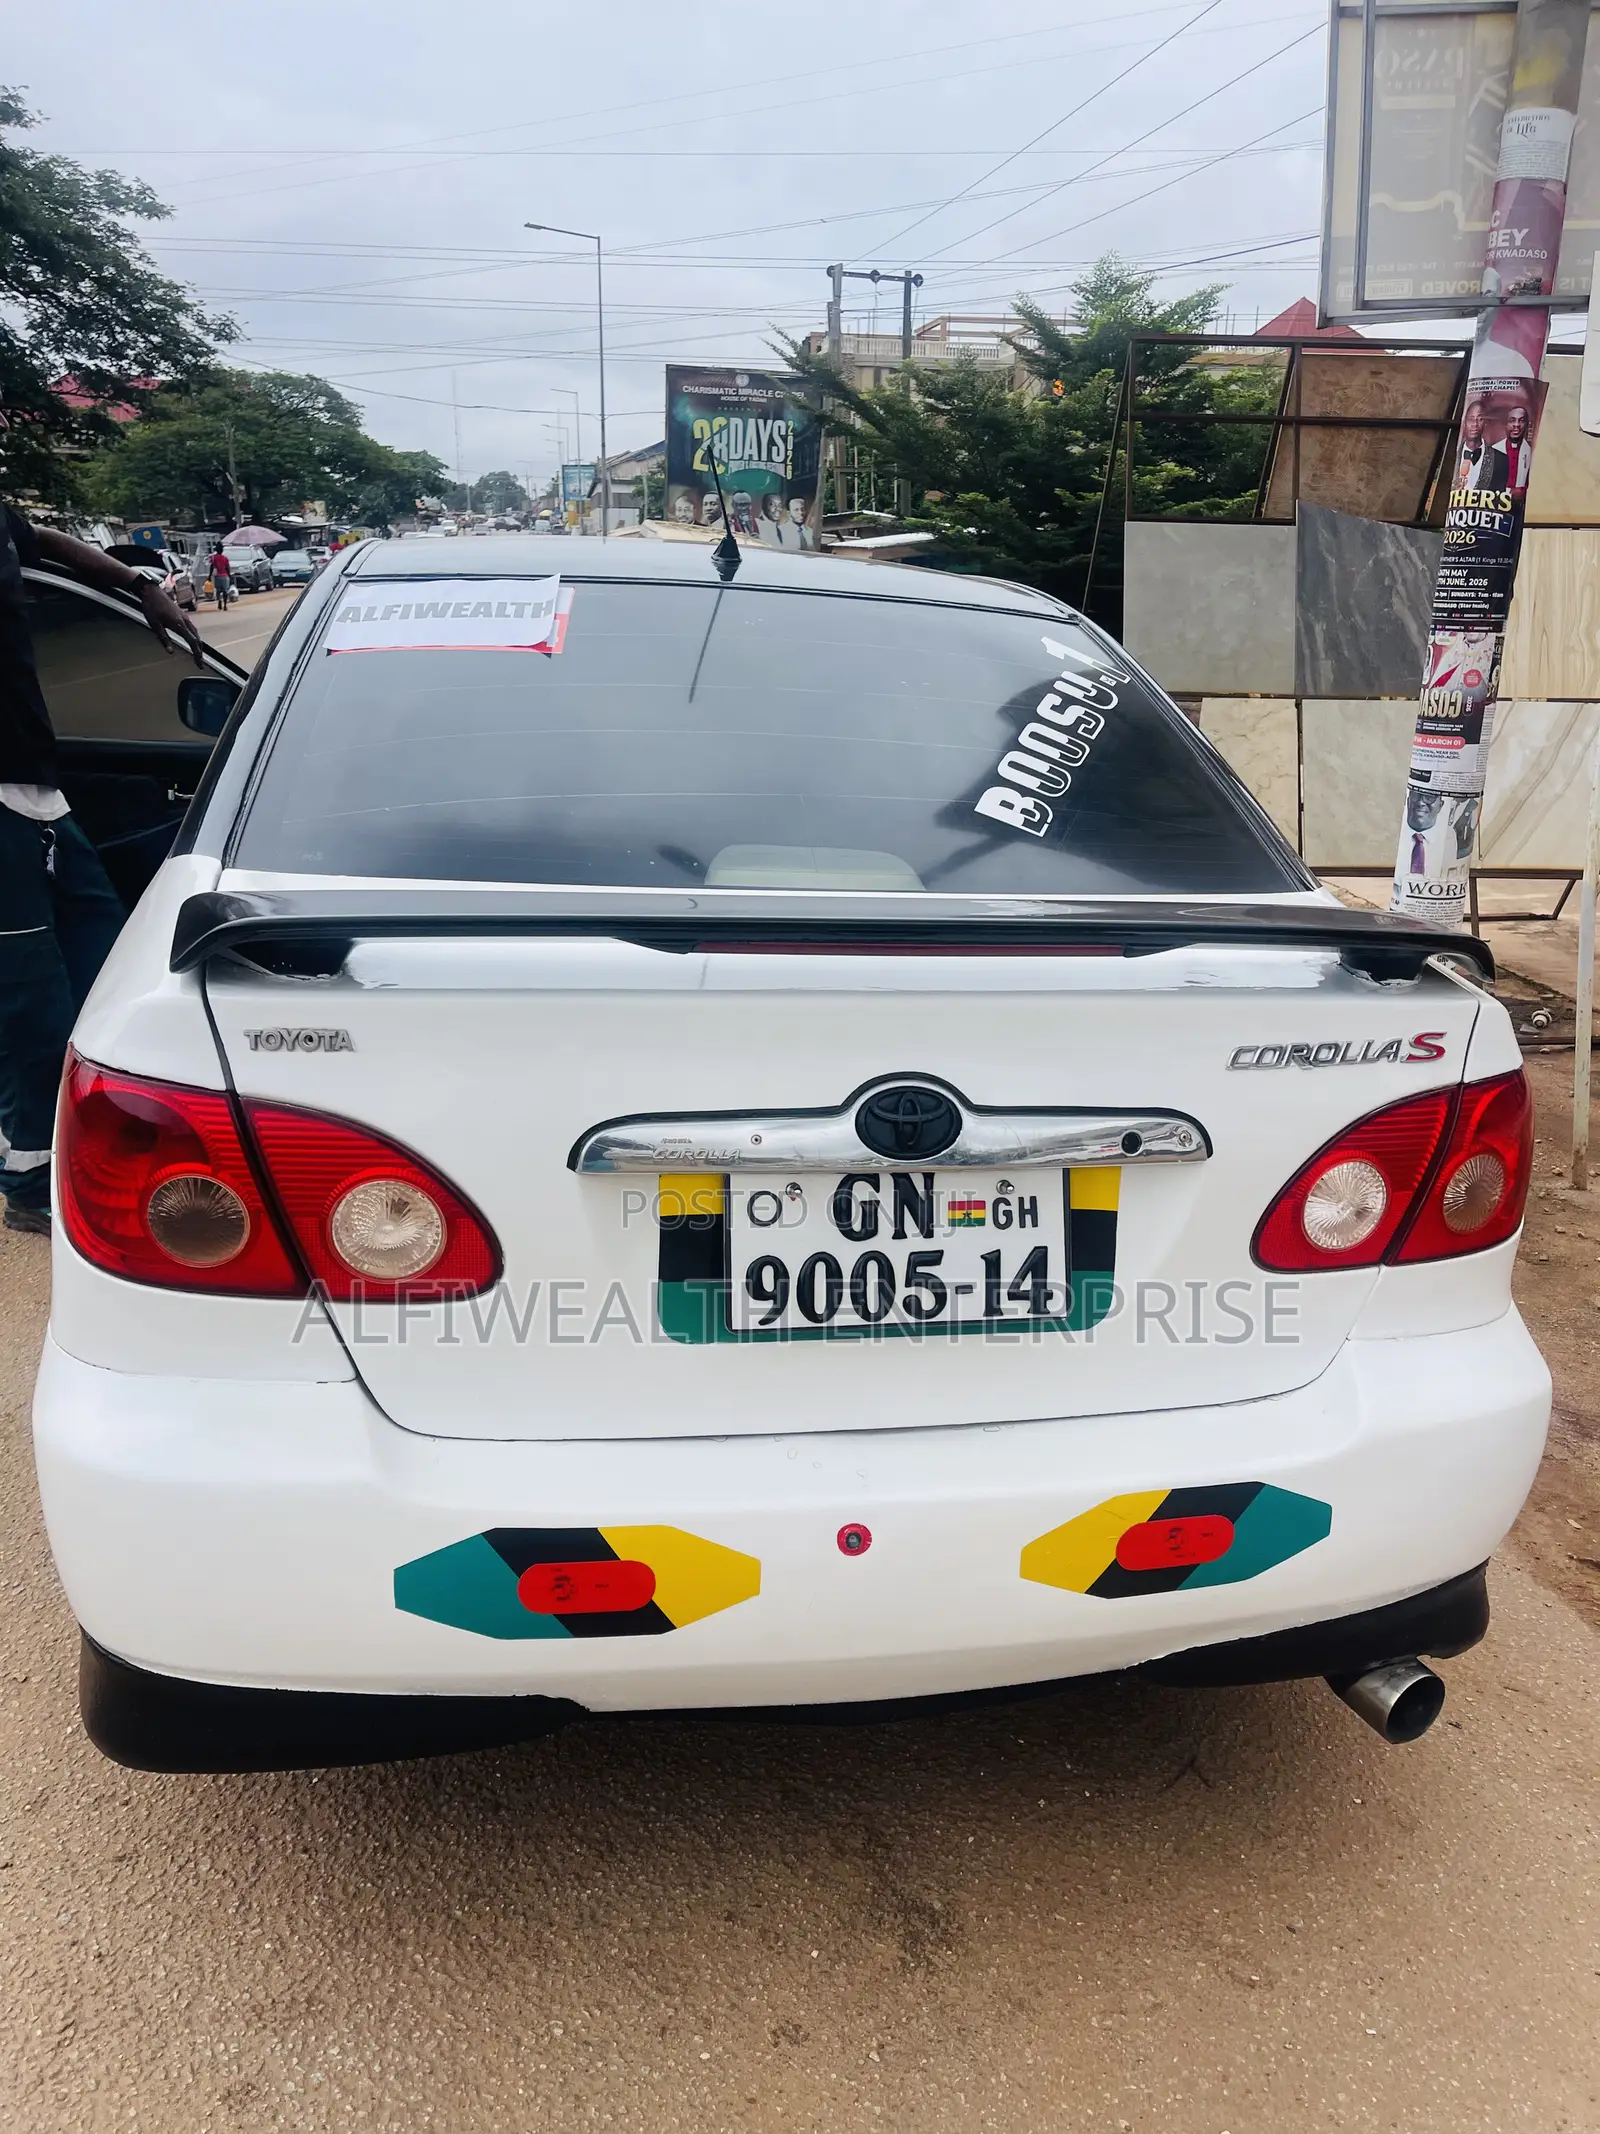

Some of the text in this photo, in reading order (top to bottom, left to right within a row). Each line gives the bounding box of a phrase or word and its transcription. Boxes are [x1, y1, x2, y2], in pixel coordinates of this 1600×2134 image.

[1516, 122, 1537, 138] Life
[1495, 249, 1548, 259] KWADASO
[682, 385, 737, 395] CHARISMATIC
[738, 388, 773, 398] MIRACLE
[692, 416, 794, 480] 28 DAYS 2026
[1444, 530, 1476, 544] 2026
[1451, 569, 1468, 577] MAY
[1446, 578, 1467, 586] JUNE,
[1468, 578, 1488, 586] 2026
[335, 599, 555, 623] ALFIWEALTH
[1426, 738, 1453, 746] MARCH
[243, 1027, 356, 1052] TOYOTA
[652, 1147, 741, 1160] COROLLA
[832, 1172, 1038, 1242] GN GH
[745, 1246, 1054, 1326] 9005-14
